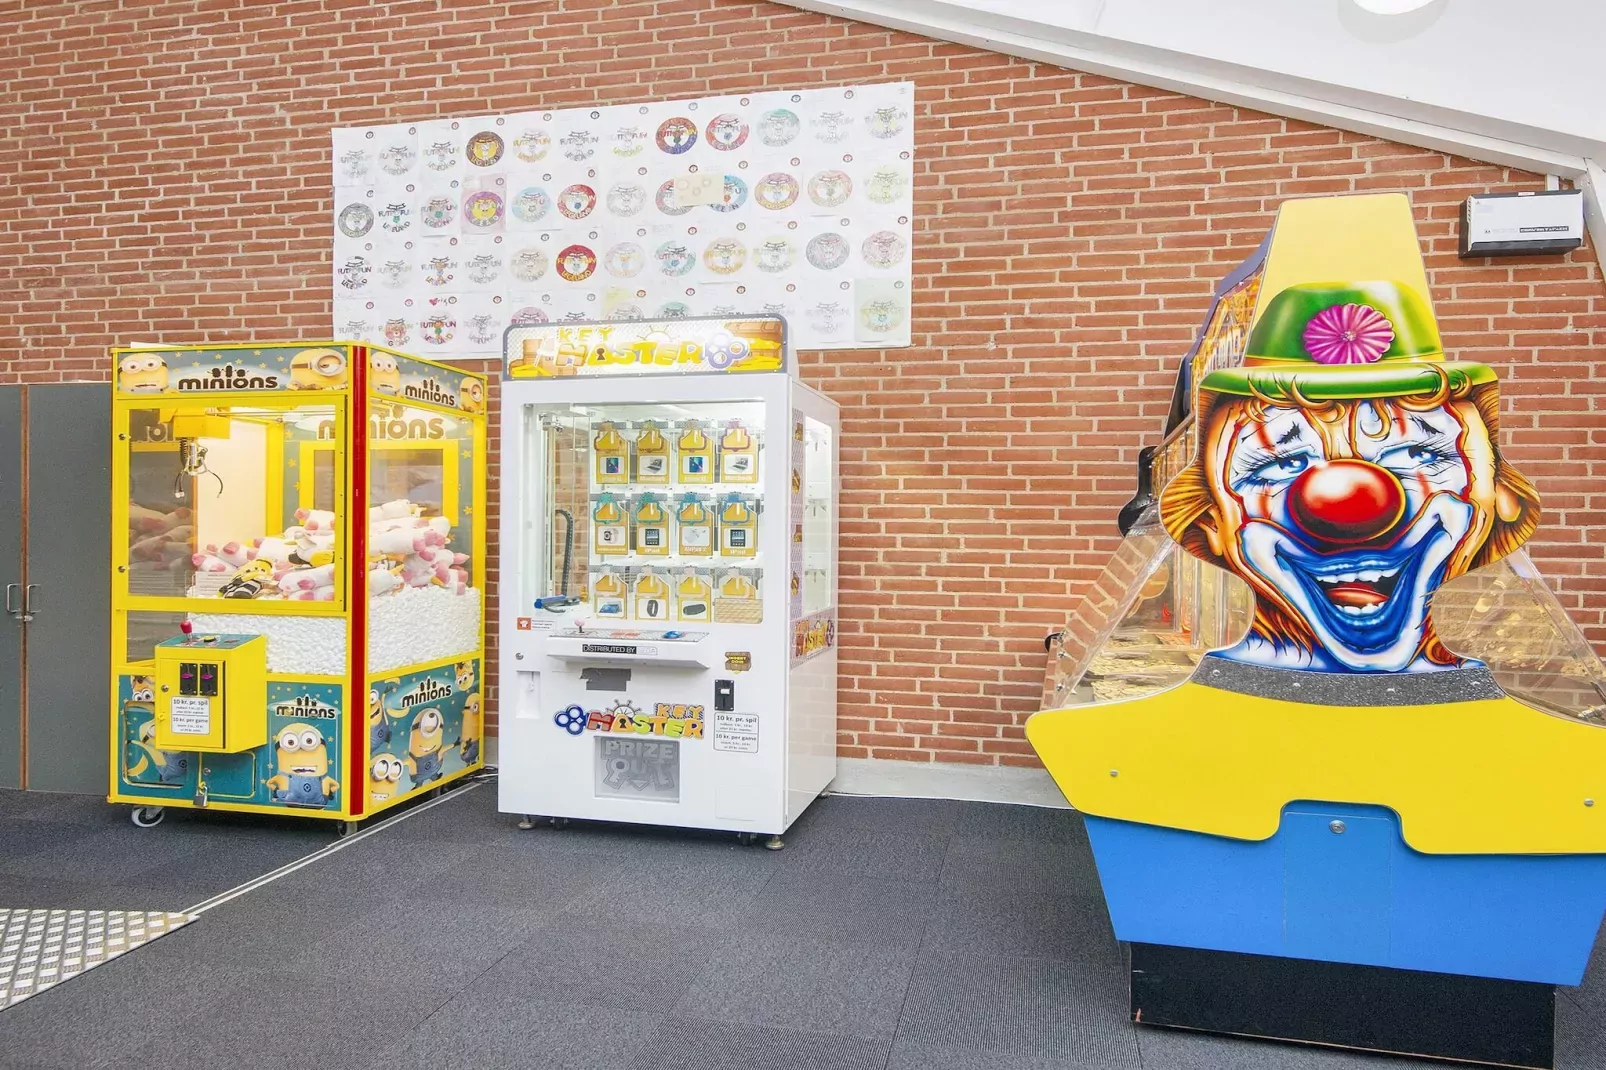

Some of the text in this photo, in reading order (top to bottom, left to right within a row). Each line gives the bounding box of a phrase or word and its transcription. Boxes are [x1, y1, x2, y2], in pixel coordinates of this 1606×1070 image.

[558, 326, 614, 341] KEY
[556, 340, 703, 366] MASTER
[178, 376, 278, 389] minions
[405, 385, 455, 406] minions
[583, 645, 625, 654] DISTRIBUTED
[402, 684, 452, 708] minions
[657, 703, 704, 719] KEY
[586, 711, 704, 740] MASTER
[605, 740, 674, 759] PRIZE
